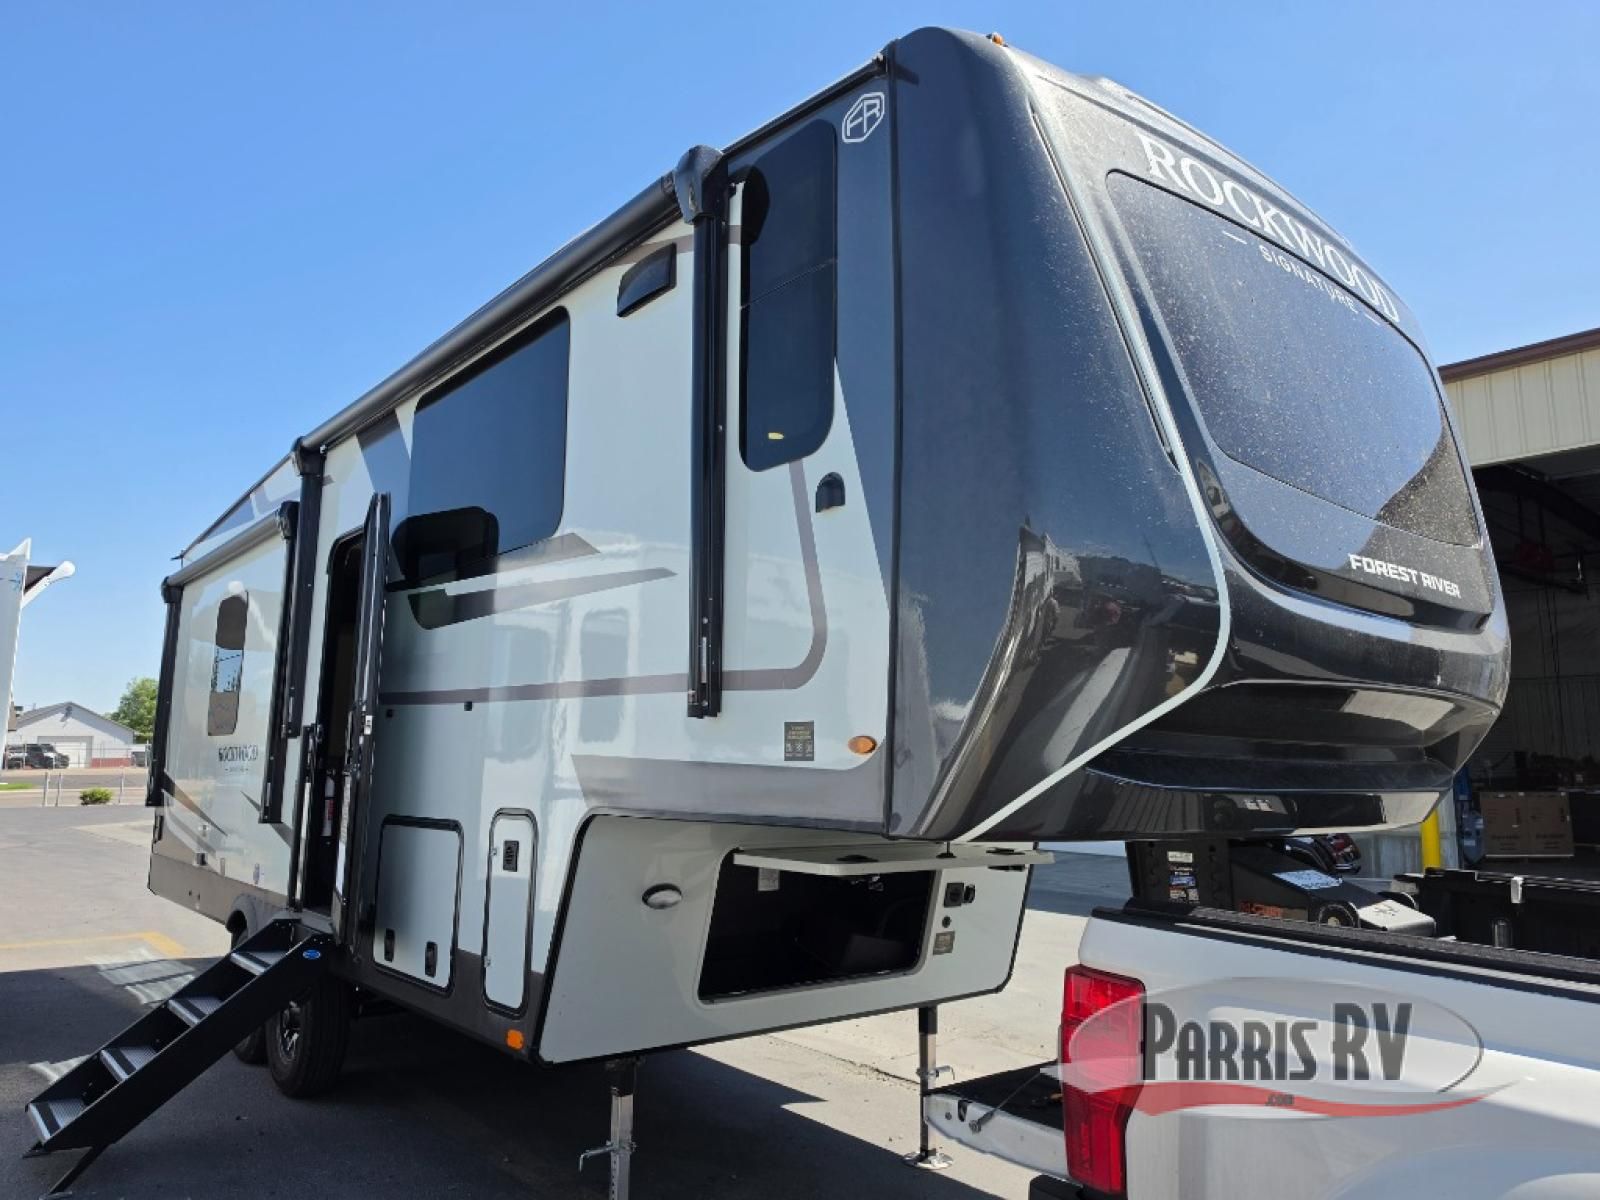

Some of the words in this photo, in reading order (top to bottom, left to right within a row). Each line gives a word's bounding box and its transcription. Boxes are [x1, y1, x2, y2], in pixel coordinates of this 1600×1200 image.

[1135, 132, 1400, 323] ROCKWOOD
[1258, 244, 1359, 314] SIGNATURE
[1348, 552, 1418, 585] FOREST
[1420, 571, 1462, 599] RIVER
